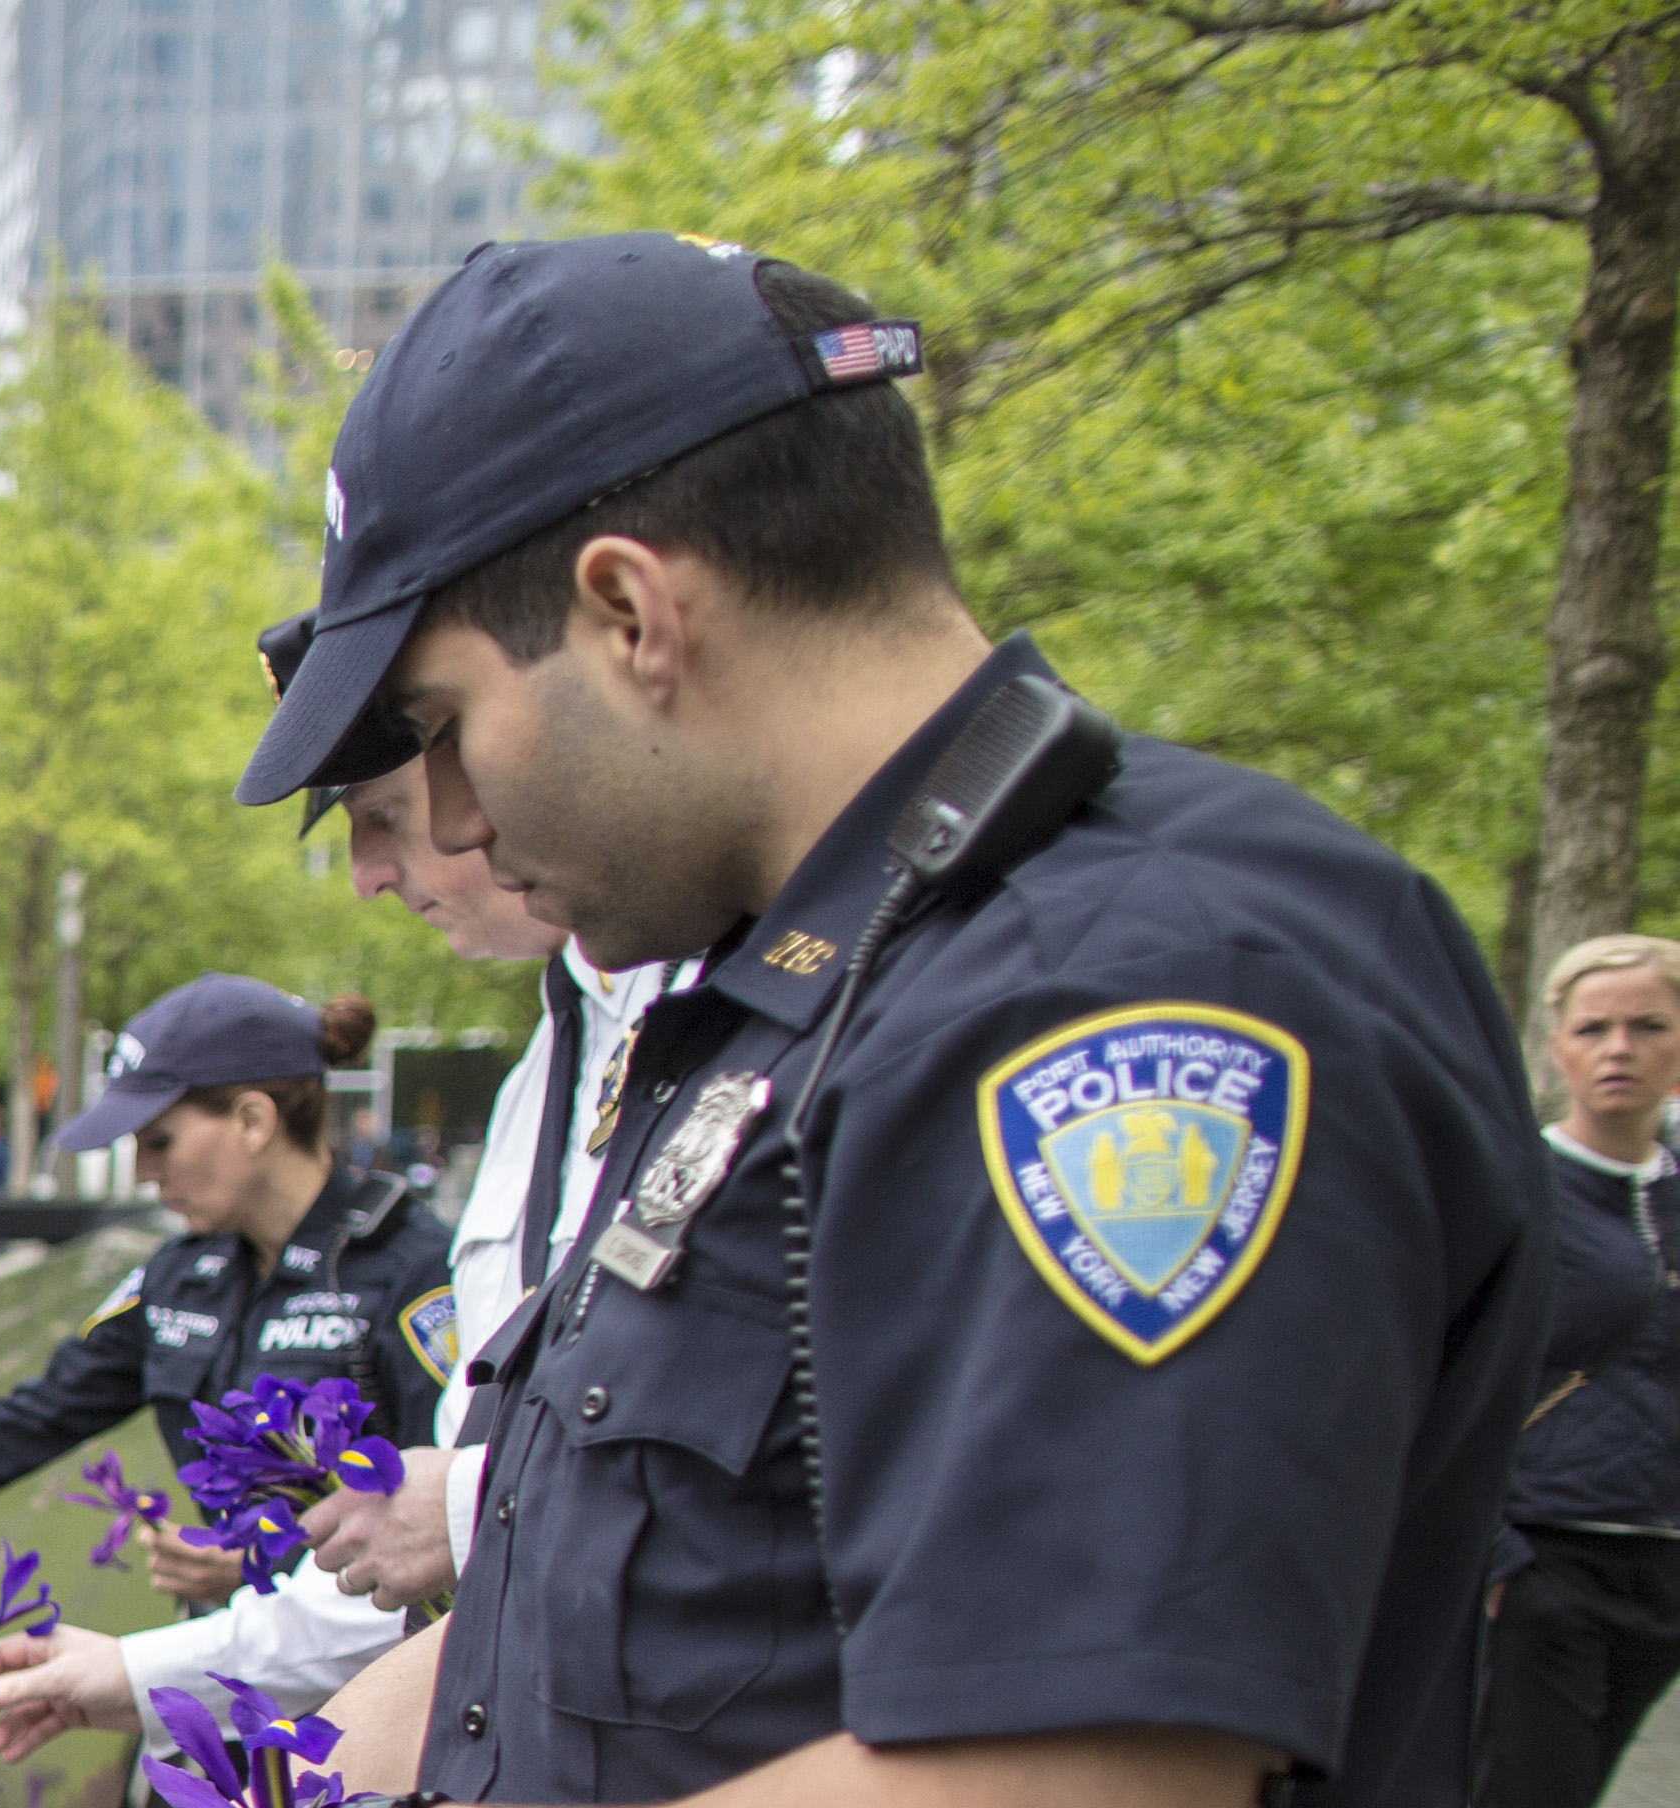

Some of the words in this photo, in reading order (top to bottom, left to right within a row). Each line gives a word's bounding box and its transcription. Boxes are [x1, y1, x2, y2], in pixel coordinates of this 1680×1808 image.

[1013, 1050, 1091, 1103] PORT
[1104, 1034, 1272, 1076] AUTHORITY
[1026, 1058, 1263, 1131] POLICE
[1018, 1161, 1070, 1222] NEW
[1059, 1233, 1130, 1309] YORK
[1157, 1246, 1227, 1314] NEW
[1218, 1134, 1279, 1244] JERSEY
